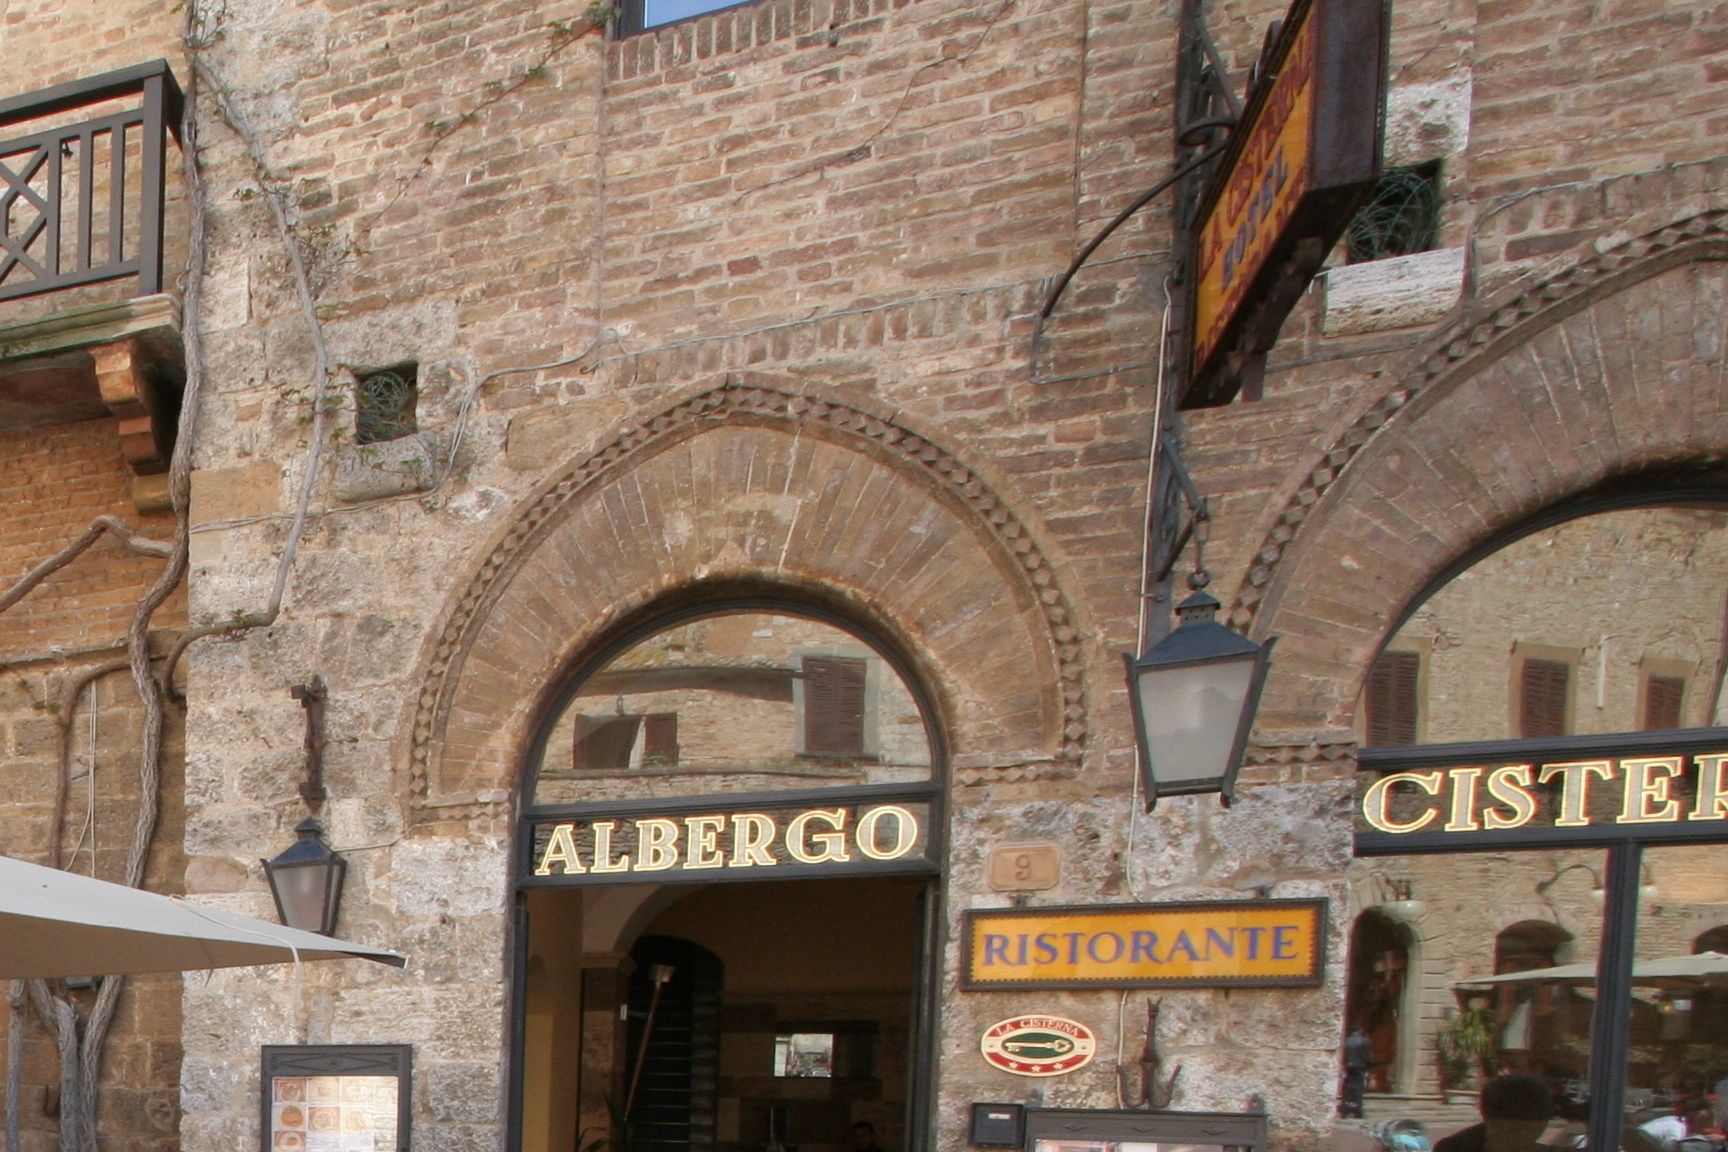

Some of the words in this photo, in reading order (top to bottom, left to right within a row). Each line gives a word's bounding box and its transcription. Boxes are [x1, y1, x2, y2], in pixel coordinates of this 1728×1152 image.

[534, 804, 918, 876] ALBERGO
[1014, 853, 1031, 882] 9
[981, 925, 1300, 968] RISTORANTE
[995, 1023, 1014, 1036] LA
[1020, 1018, 1079, 1037] CISTERNA
